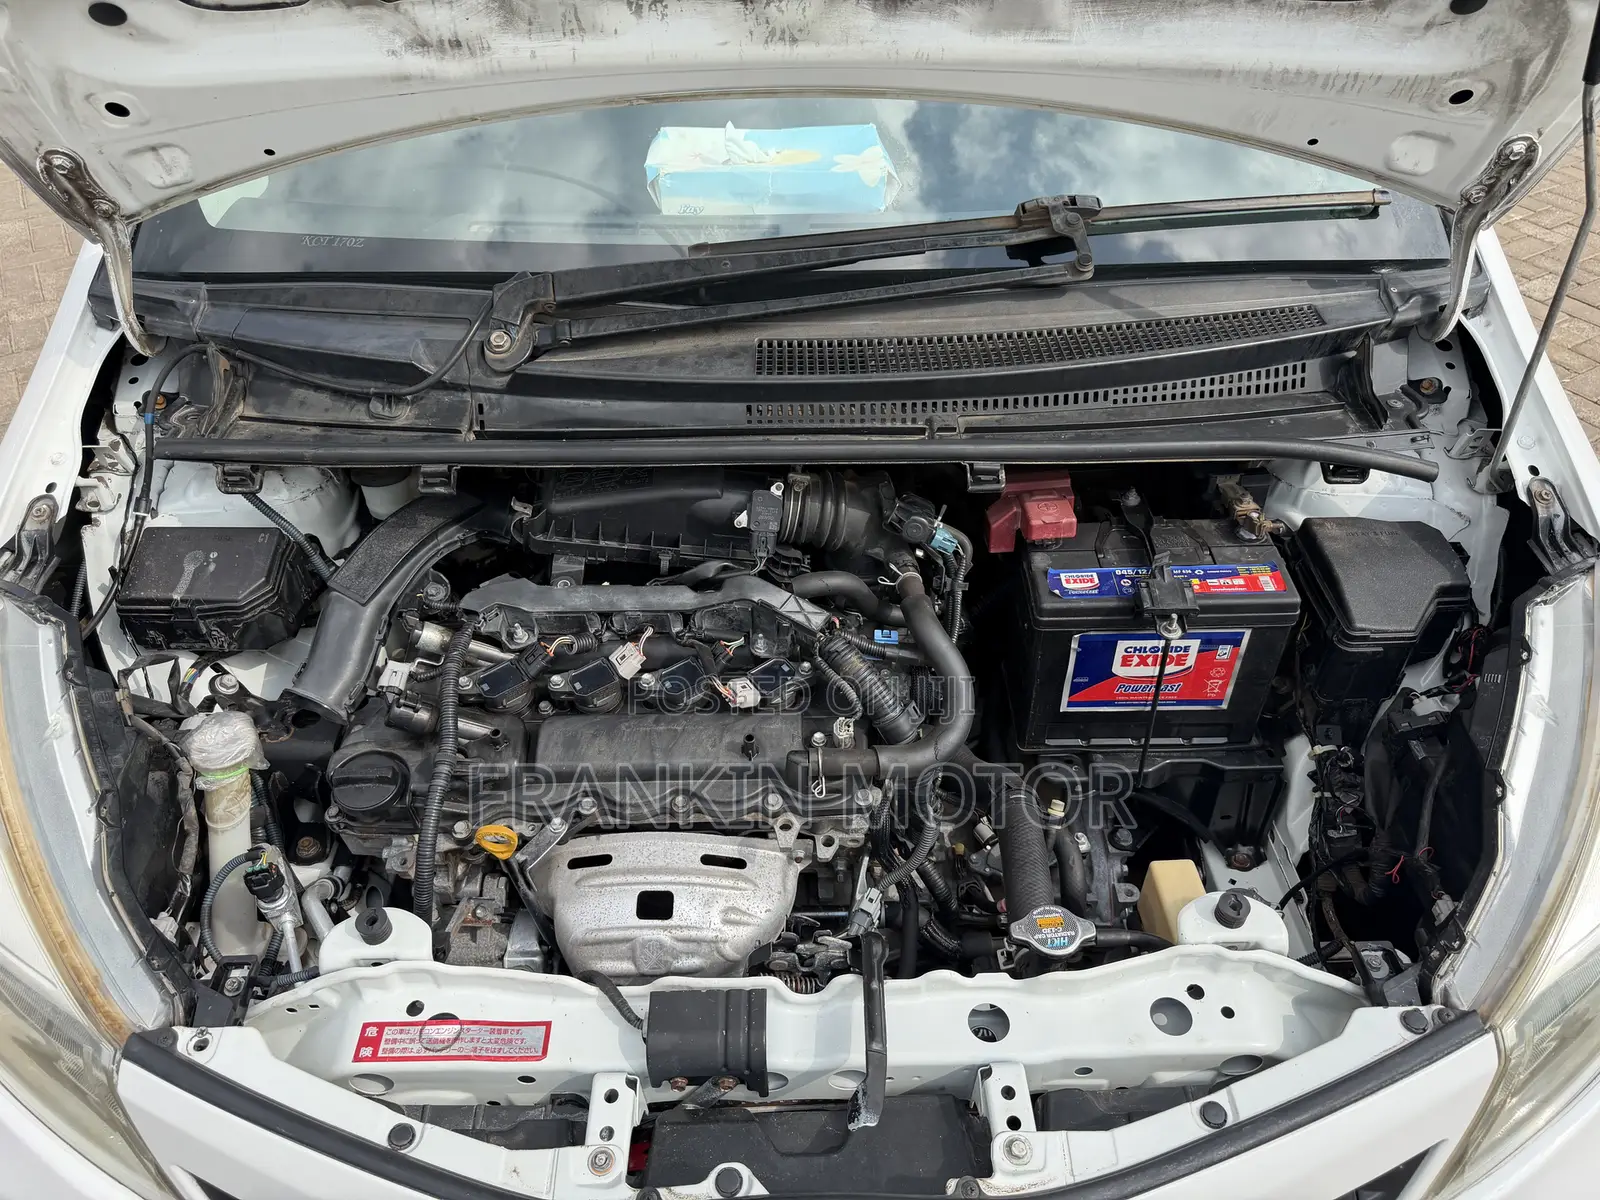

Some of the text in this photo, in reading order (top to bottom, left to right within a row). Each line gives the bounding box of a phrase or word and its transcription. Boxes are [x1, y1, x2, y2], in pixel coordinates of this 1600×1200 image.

[301, 235, 365, 248] KCT 170Z
[1064, 577, 1096, 585] EXIDE
[1119, 653, 1190, 668] EXIDE
[1114, 682, 1183, 694] Powerast
